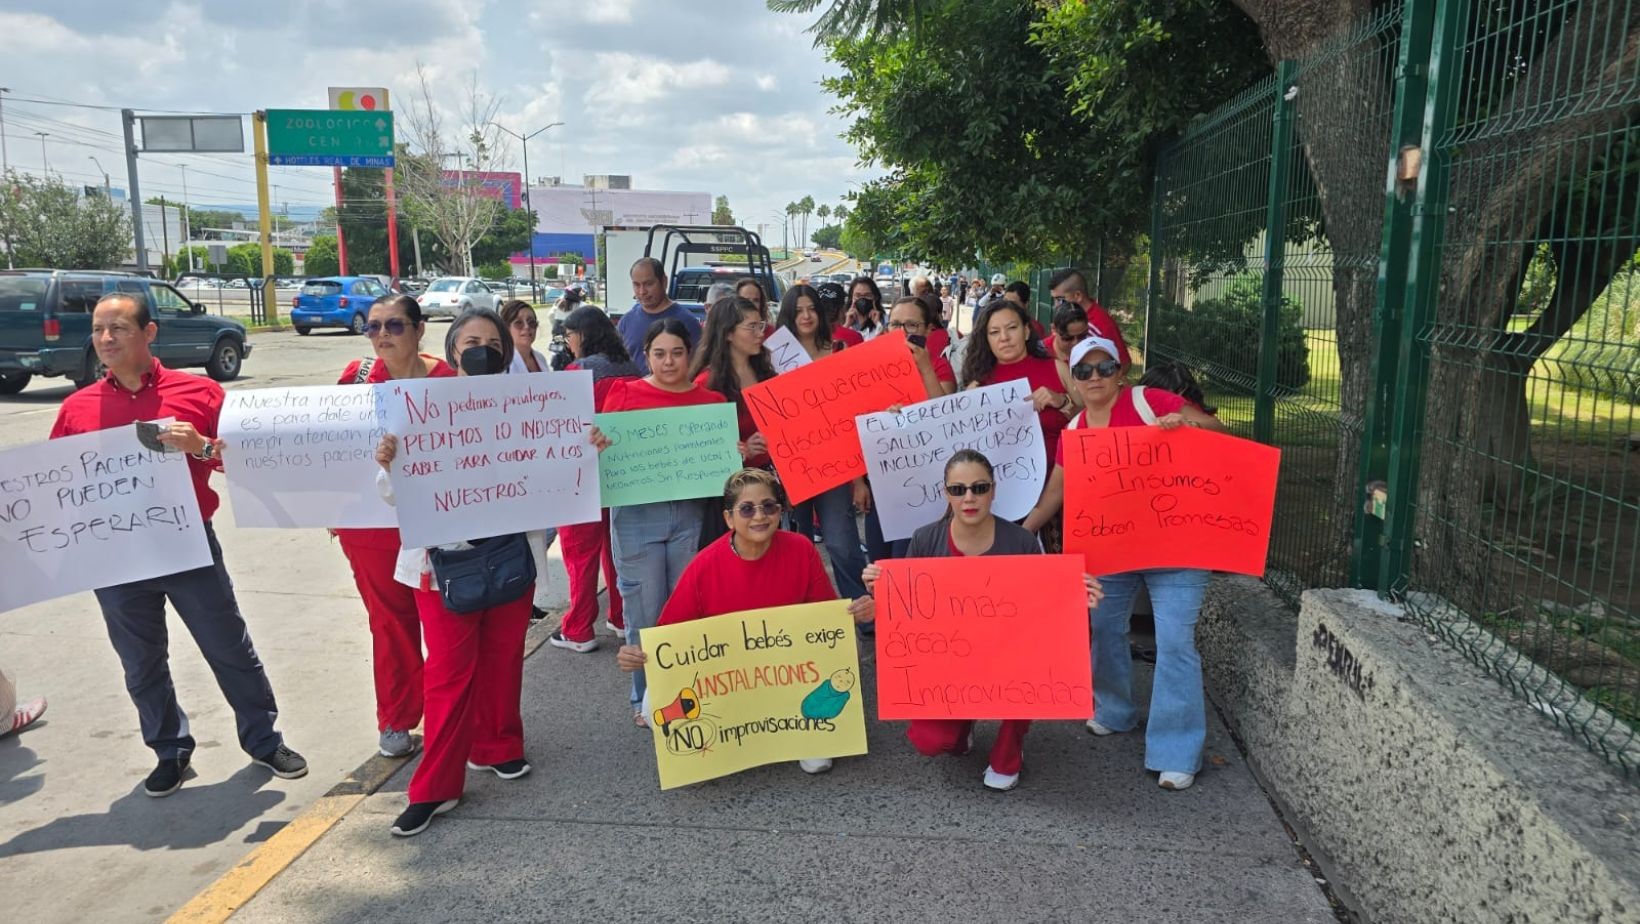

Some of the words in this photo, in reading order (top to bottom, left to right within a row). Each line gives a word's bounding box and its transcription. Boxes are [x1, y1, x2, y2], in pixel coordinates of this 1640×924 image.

[350, 156, 360, 165] DE
[365, 156, 390, 165] MINAS
[748, 386, 800, 427] No
[803, 360, 912, 427] queremos
[866, 417, 888, 433] EL
[895, 396, 971, 427] DERECHO
[980, 392, 992, 407] A
[1002, 387, 1020, 403] LA
[240, 416, 261, 430] es
[273, 412, 310, 433] para
[610, 425, 621, 446] 3
[777, 418, 856, 459] discurs
[877, 430, 932, 455] SALUD
[941, 408, 1023, 439] TAMBIEN
[404, 427, 482, 454] PEDIMOS
[1078, 431, 1172, 468] Faltan
[245, 450, 312, 470] nuestros
[323, 447, 378, 468] pacien
[402, 460, 442, 478] SABLE
[455, 453, 491, 470] PARA
[497, 447, 537, 463] CUIDAR
[546, 446, 556, 459] A
[561, 445, 583, 459] LOS
[789, 453, 866, 485] Recu
[880, 449, 946, 475] INCLUYE
[0, 464, 73, 494] ESTROS
[56, 477, 154, 510] PUEDEN
[18, 505, 190, 553] ESPERAR!!
[1071, 509, 1136, 538] Sobran
[886, 567, 937, 621] NO
[949, 575, 1018, 618] más
[655, 634, 730, 670] Cuidar
[741, 620, 793, 651] bebés
[805, 627, 846, 649] exige
[885, 622, 972, 658] áreas
[696, 661, 820, 699] INSTALACIONES
[673, 725, 705, 752] NO
[720, 715, 836, 746] improvisaciones
